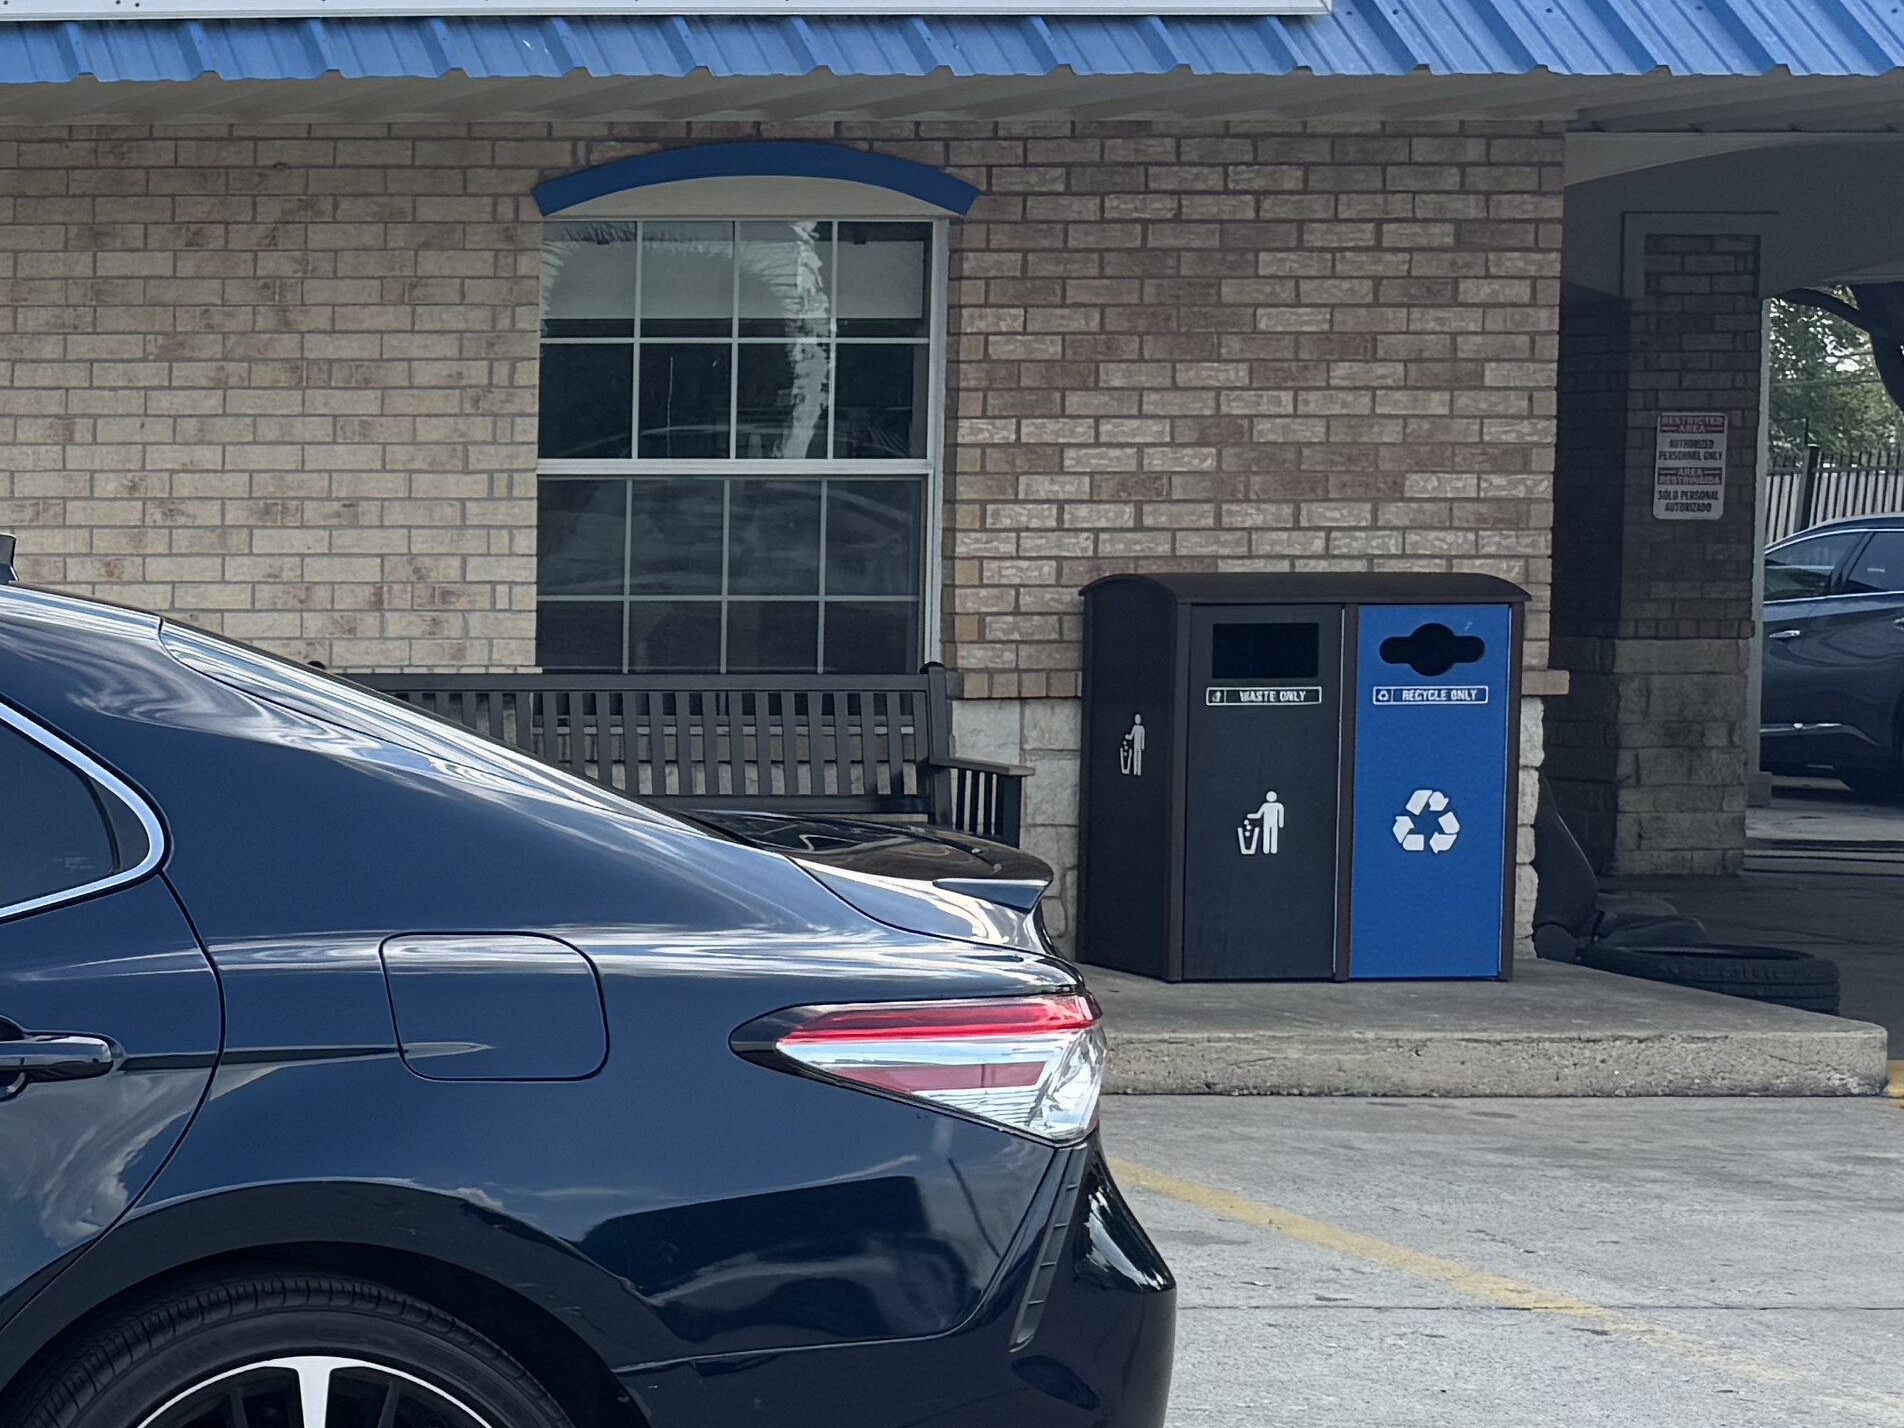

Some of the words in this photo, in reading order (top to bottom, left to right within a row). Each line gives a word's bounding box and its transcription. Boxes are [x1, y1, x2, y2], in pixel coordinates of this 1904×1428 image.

[1679, 425, 1706, 433] AREA
[1704, 451, 1723, 461] ONLY
[1680, 490, 1719, 501] PERSONAL
[1664, 502, 1712, 513] AUTORIZADO
[1239, 689, 1276, 703] WASTE
[1278, 689, 1307, 703] ONLY
[1401, 689, 1447, 703] RECYCLE
[1450, 688, 1478, 702] ONLY
